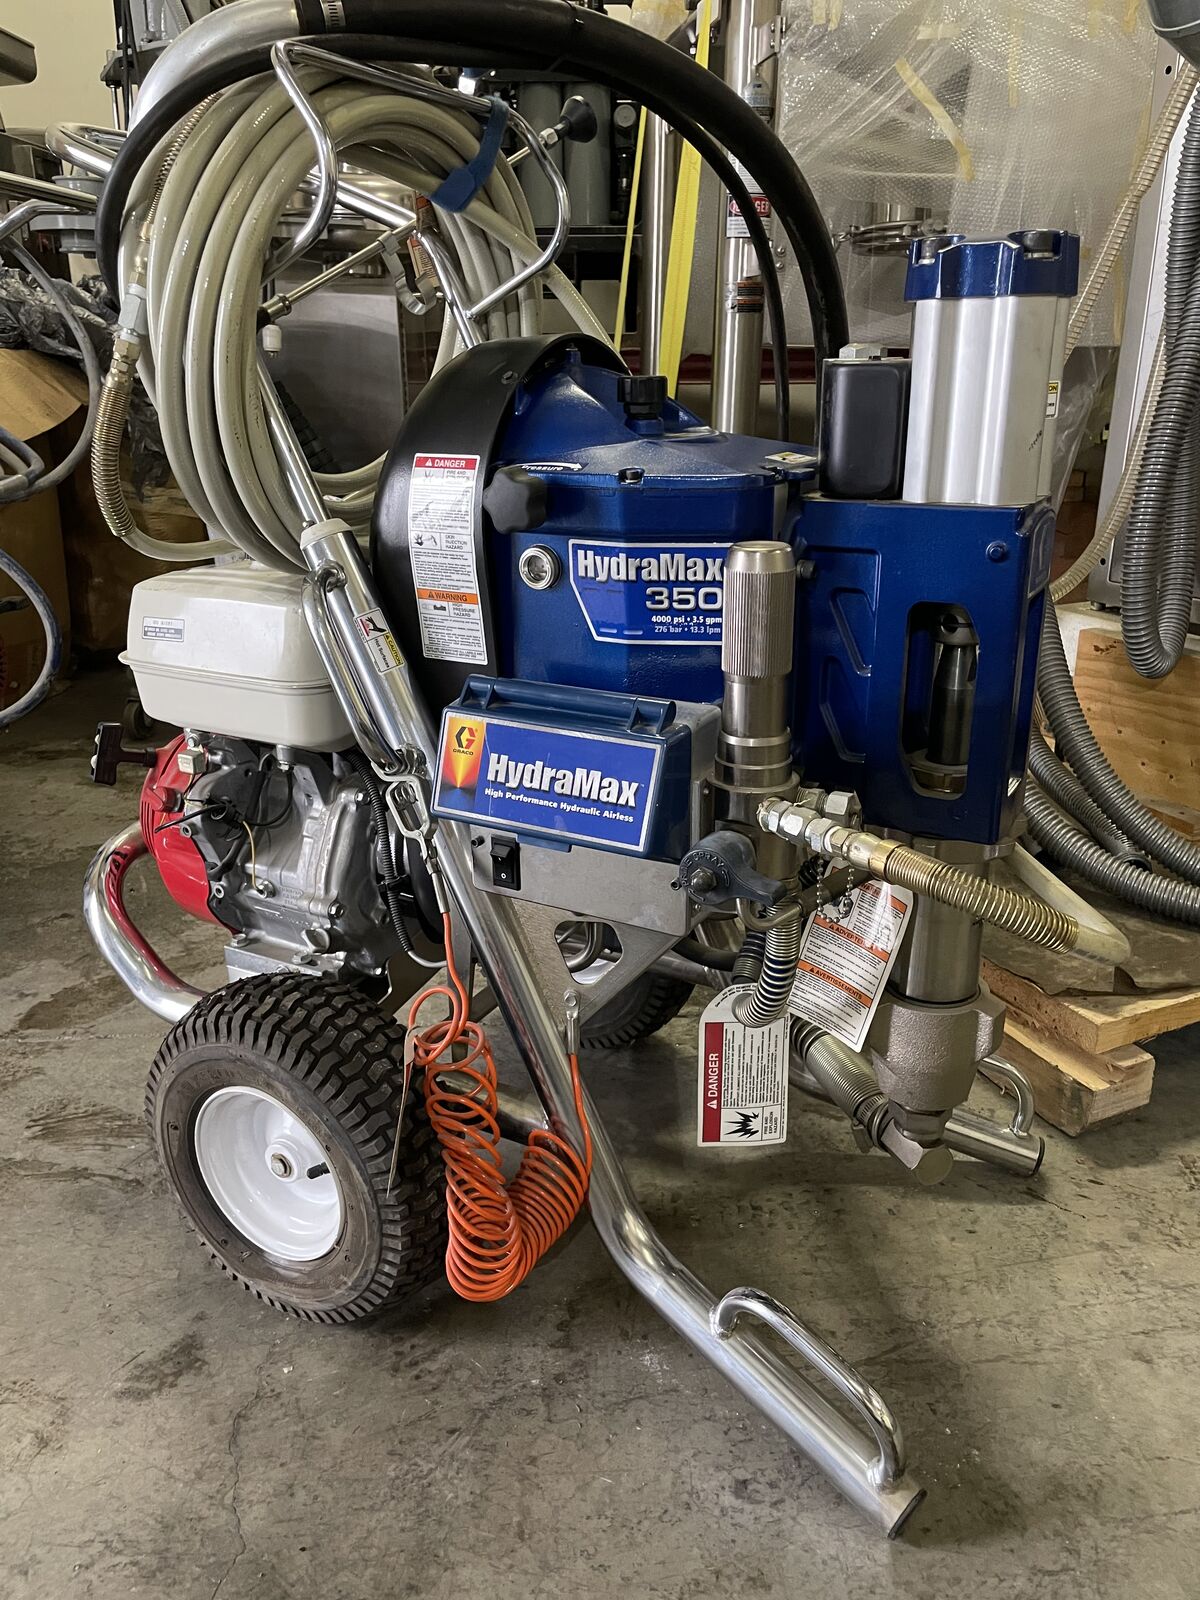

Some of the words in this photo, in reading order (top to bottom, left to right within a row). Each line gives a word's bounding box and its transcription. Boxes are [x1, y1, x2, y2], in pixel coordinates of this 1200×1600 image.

[434, 459, 466, 468] DANGER
[577, 549, 723, 583] HydraMax
[435, 591, 467, 602] WARNING
[645, 586, 723, 610] 350
[651, 615, 671, 623] 4000
[673, 615, 685, 624] psi
[692, 615, 704, 623] 3.5
[705, 617, 722, 625] gpm
[654, 625, 667, 633] 276
[669, 625, 682, 633] bar
[689, 625, 704, 633] 13.3
[452, 748, 474, 756] GRACO
[487, 753, 639, 808] HydraMax
[484, 788, 503, 798] High
[505, 792, 558, 808] Performance
[560, 801, 601, 816] Hydraulic
[602, 810, 634, 822] Airless
[707, 1053, 719, 1097] DANGER
